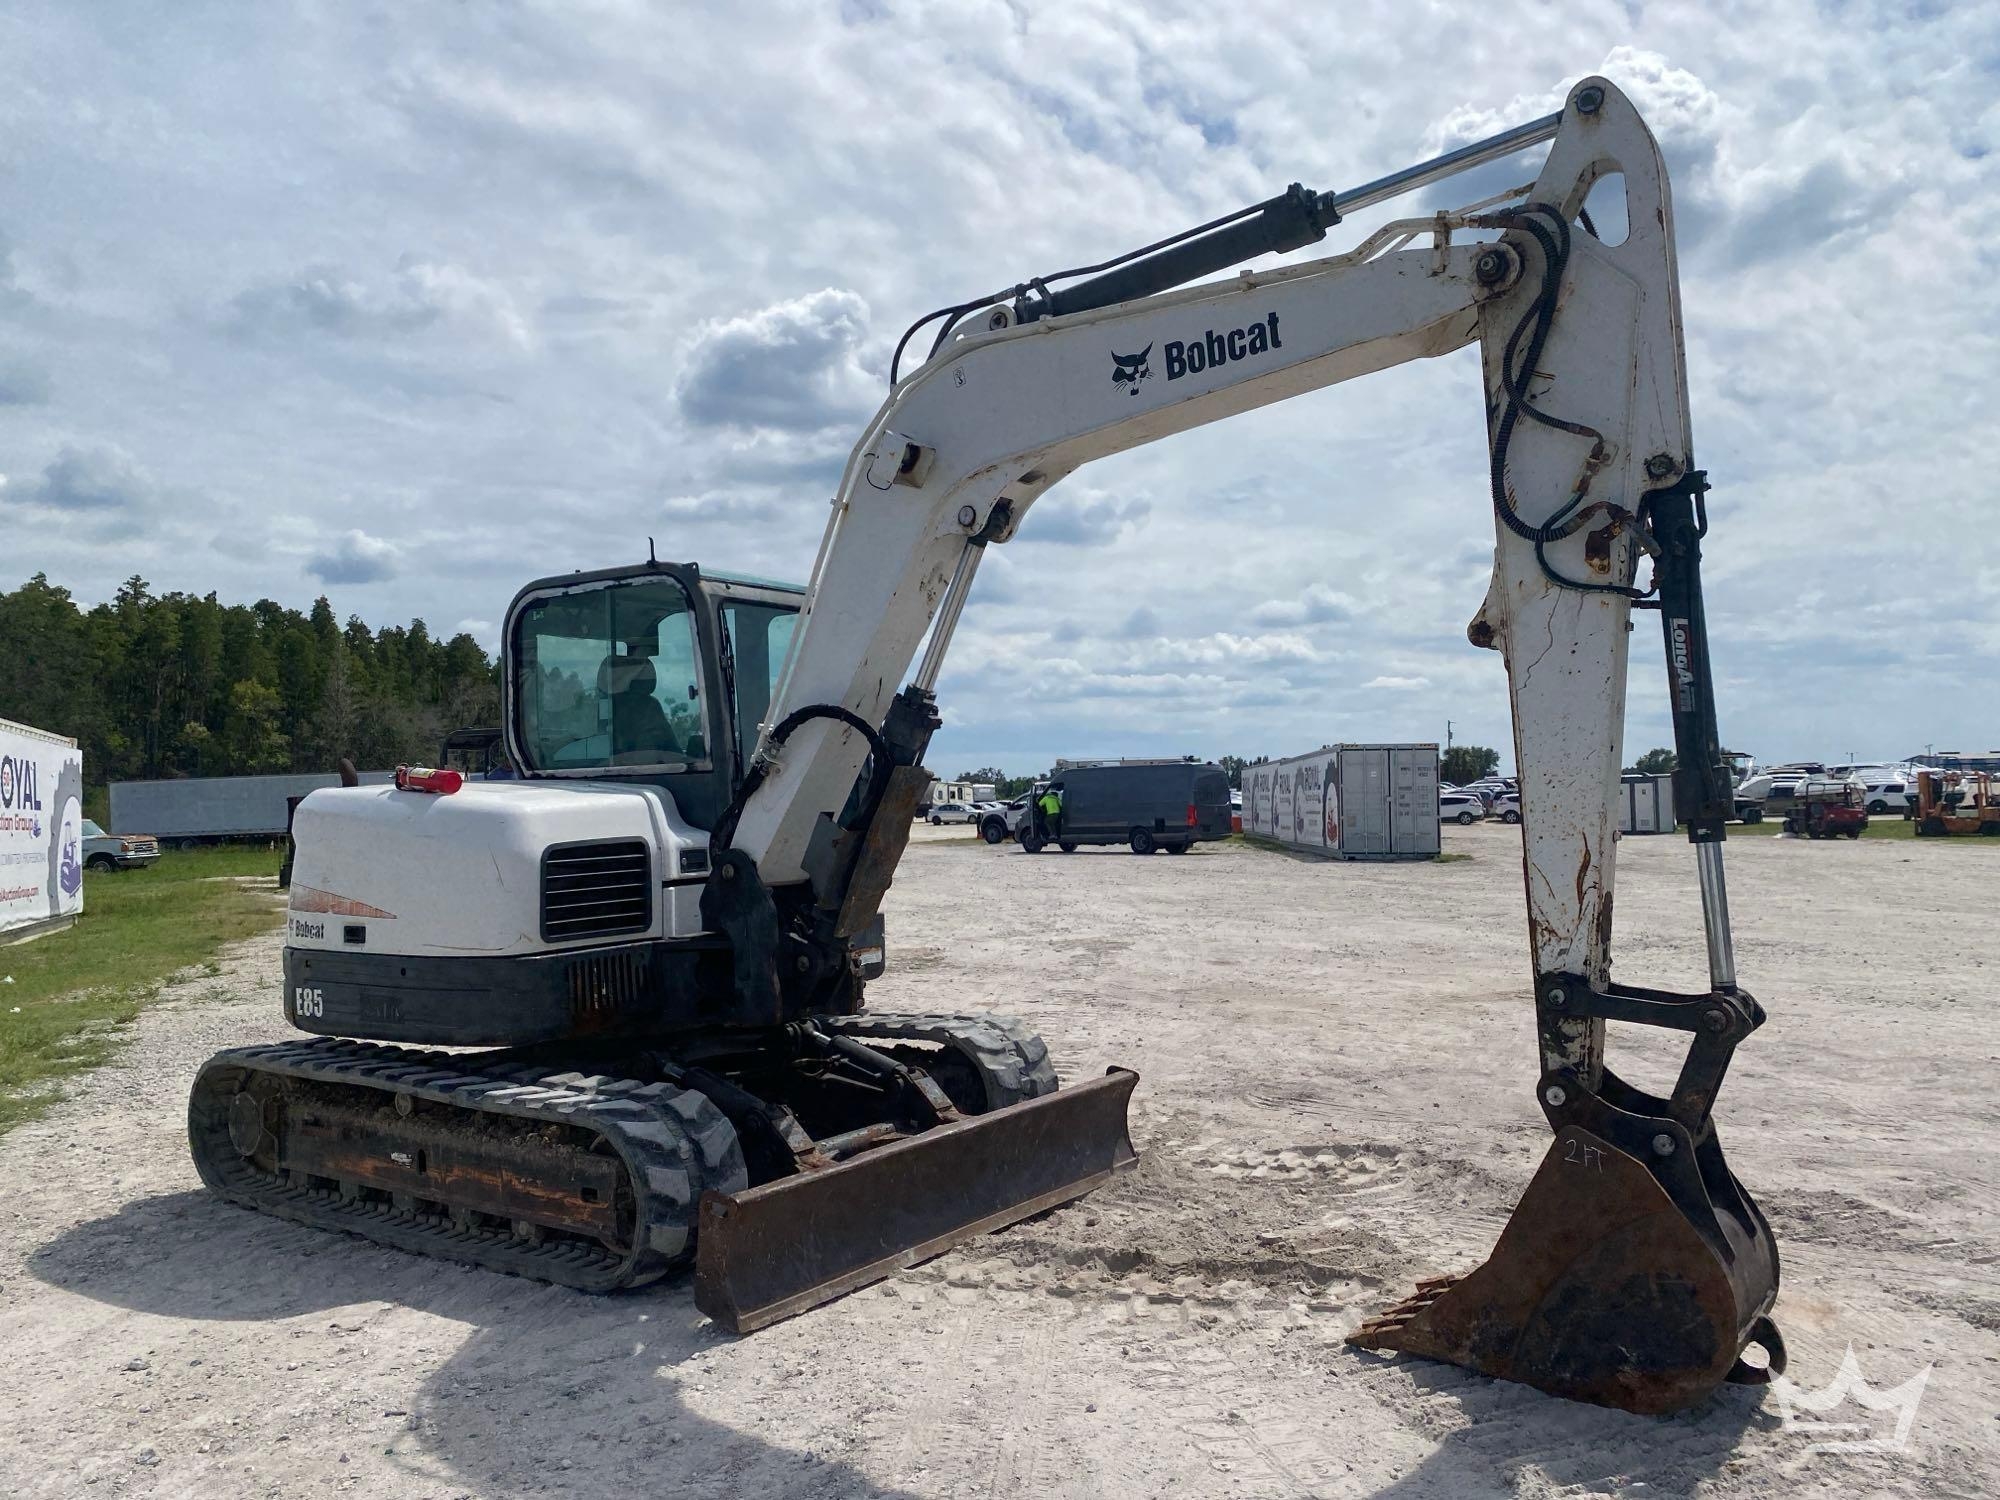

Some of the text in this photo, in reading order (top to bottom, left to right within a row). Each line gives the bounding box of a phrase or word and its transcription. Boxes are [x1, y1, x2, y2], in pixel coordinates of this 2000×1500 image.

[1165, 312, 1282, 381] Bobcat
[295, 920, 325, 939] Bobcat
[295, 987, 324, 1018] E85
